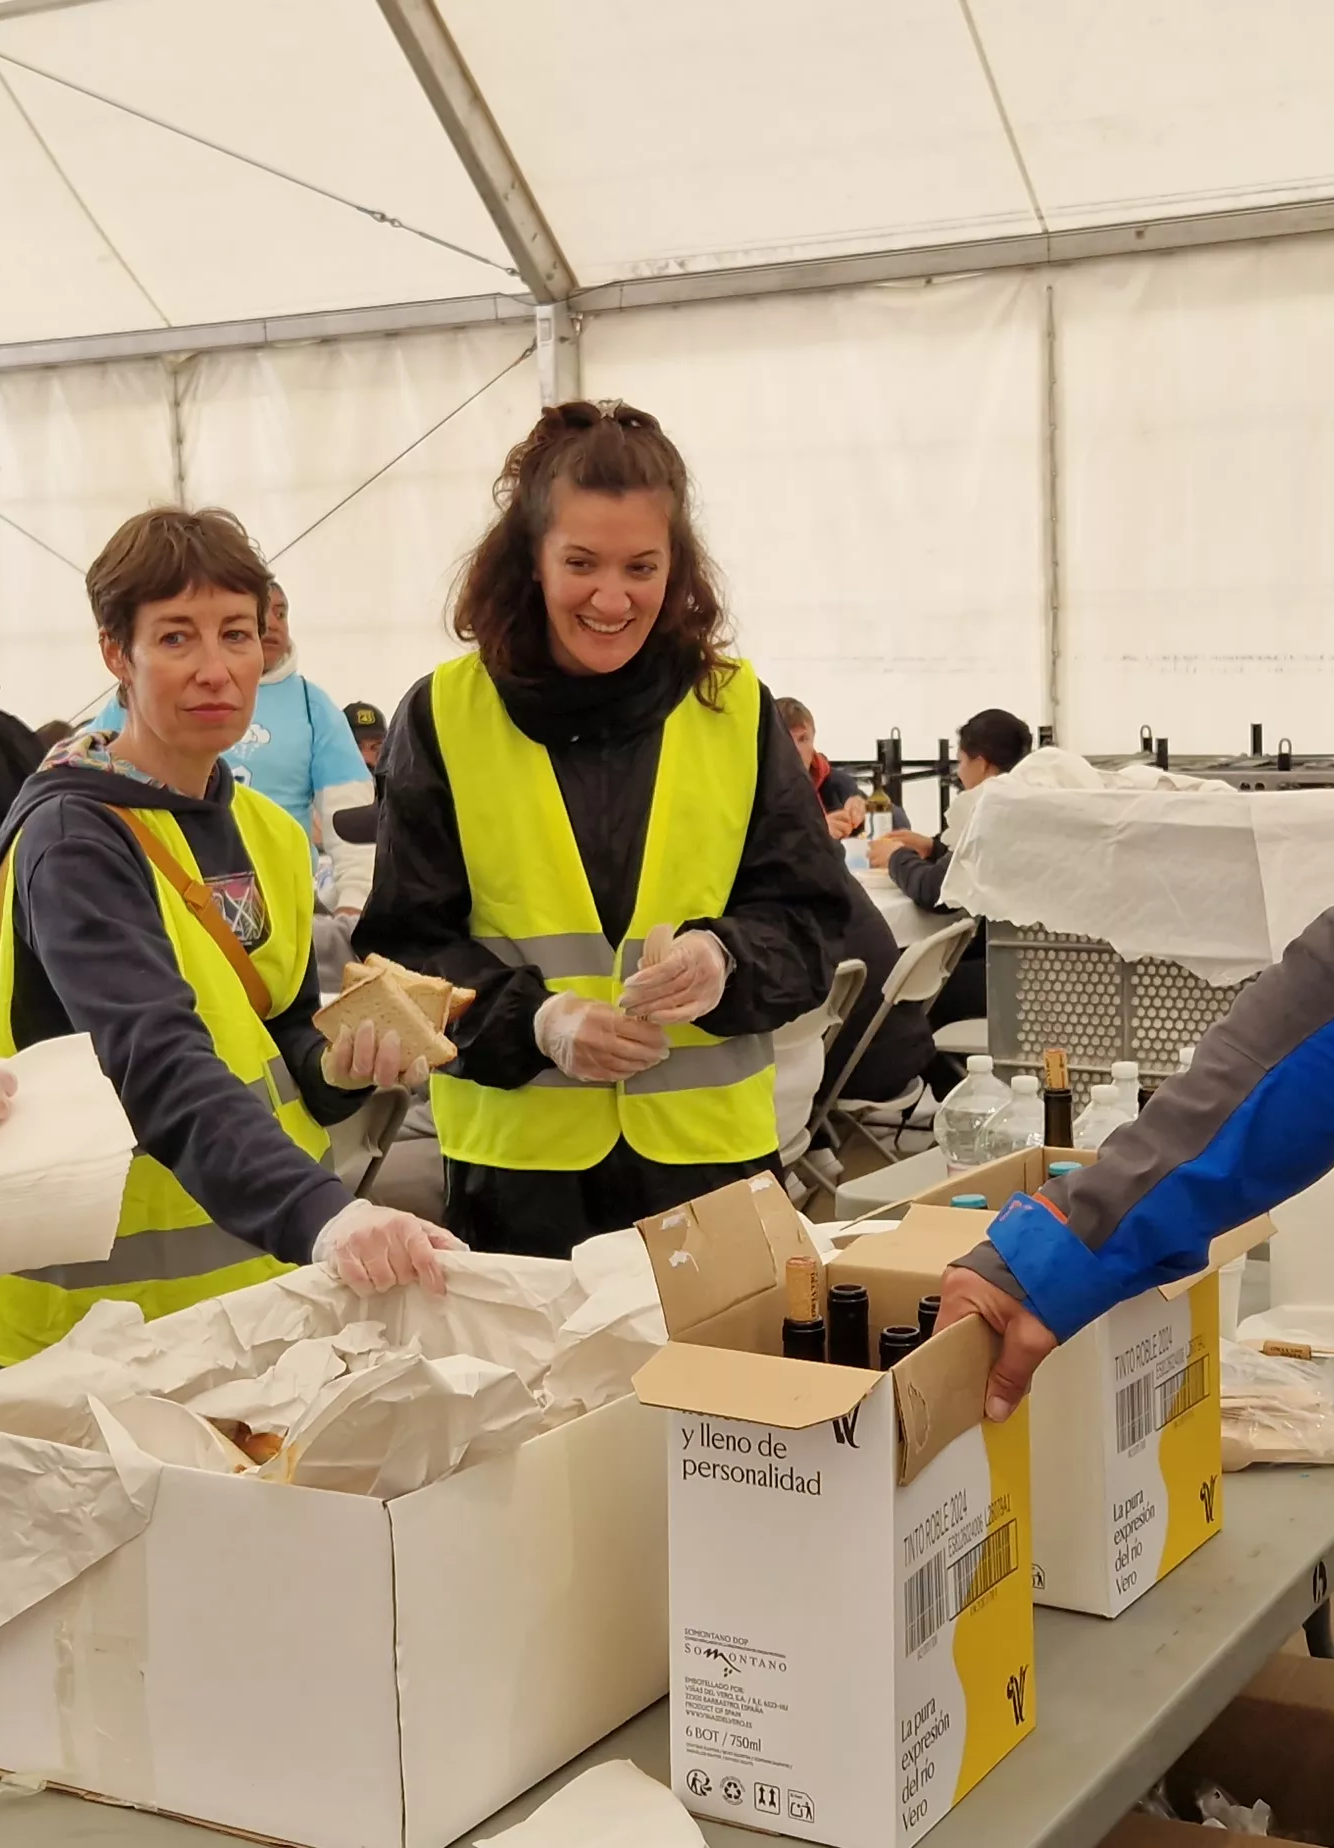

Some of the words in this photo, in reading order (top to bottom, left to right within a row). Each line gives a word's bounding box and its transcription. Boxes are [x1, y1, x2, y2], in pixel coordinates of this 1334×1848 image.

[681, 1427, 695, 1450] y
[700, 1422, 752, 1454] lleno
[757, 1432, 787, 1459] de
[682, 1458, 822, 1496] personalidad
[1113, 1503, 1124, 1522] La
[1125, 1489, 1144, 1520] pura
[1113, 1501, 1156, 1546] expresión
[903, 1523, 925, 1568] TINTO
[925, 1501, 950, 1548] ROBLE
[950, 1487, 968, 1528] 2024
[1114, 1544, 1130, 1572] del
[1130, 1537, 1143, 1562] río
[1115, 1570, 1138, 1596] Vero
[685, 1724, 693, 1737] 6
[695, 1726, 720, 1743] BOT
[722, 1731, 728, 1747] /
[729, 1733, 762, 1752] 750ml
[901, 1719, 913, 1743] La
[914, 1697, 936, 1736] pura
[901, 1709, 950, 1771] expresión
[901, 1767, 919, 1805] del
[920, 1757, 935, 1787] río
[902, 1798, 928, 1832] Vero
